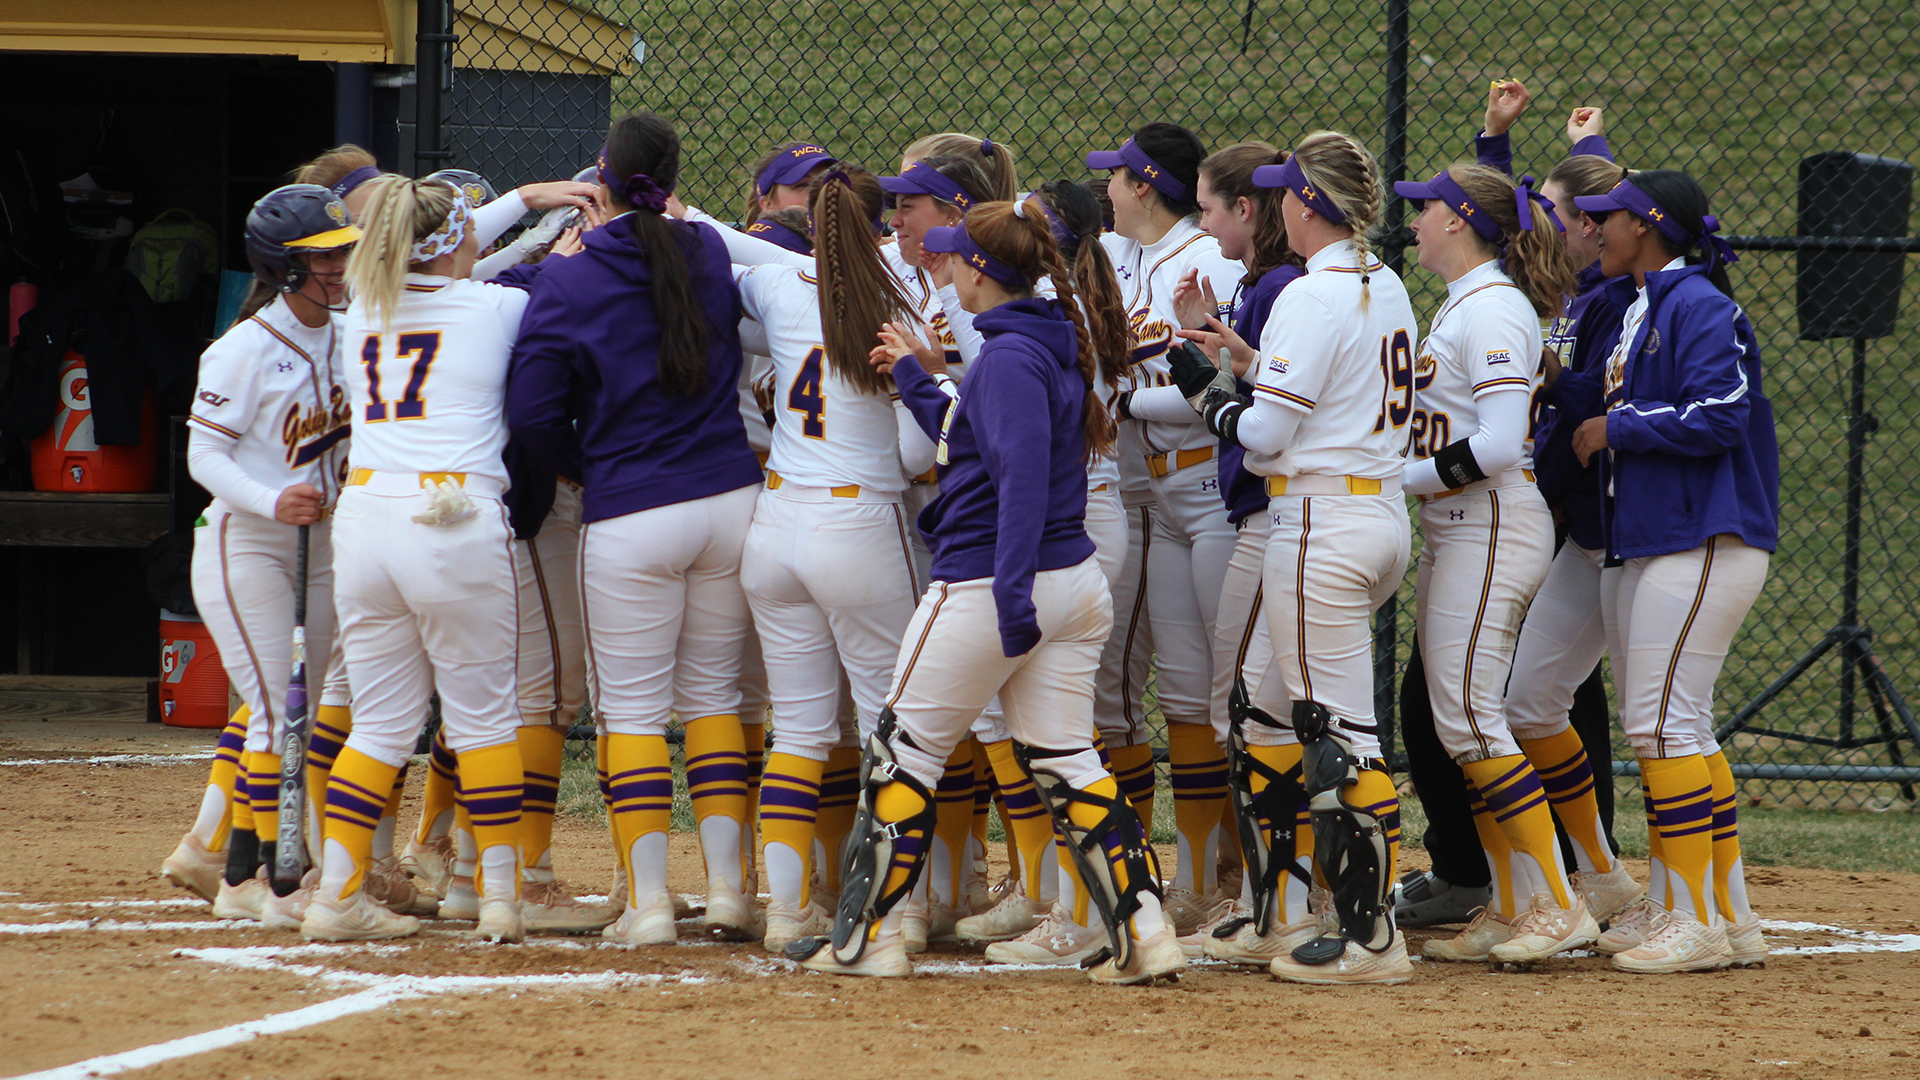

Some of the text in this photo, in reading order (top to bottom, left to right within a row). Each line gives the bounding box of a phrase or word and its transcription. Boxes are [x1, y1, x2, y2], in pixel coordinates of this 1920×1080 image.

[791, 146, 825, 157] WCU
[361, 330, 443, 424] 17
[1269, 358, 1290, 372] PSAC
[1486, 352, 1511, 362] PSAC
[60, 367, 92, 411] G
[786, 344, 828, 441] 4
[1371, 327, 1413, 435] 19
[1413, 408, 1451, 460] 20
[162, 645, 174, 673] G
